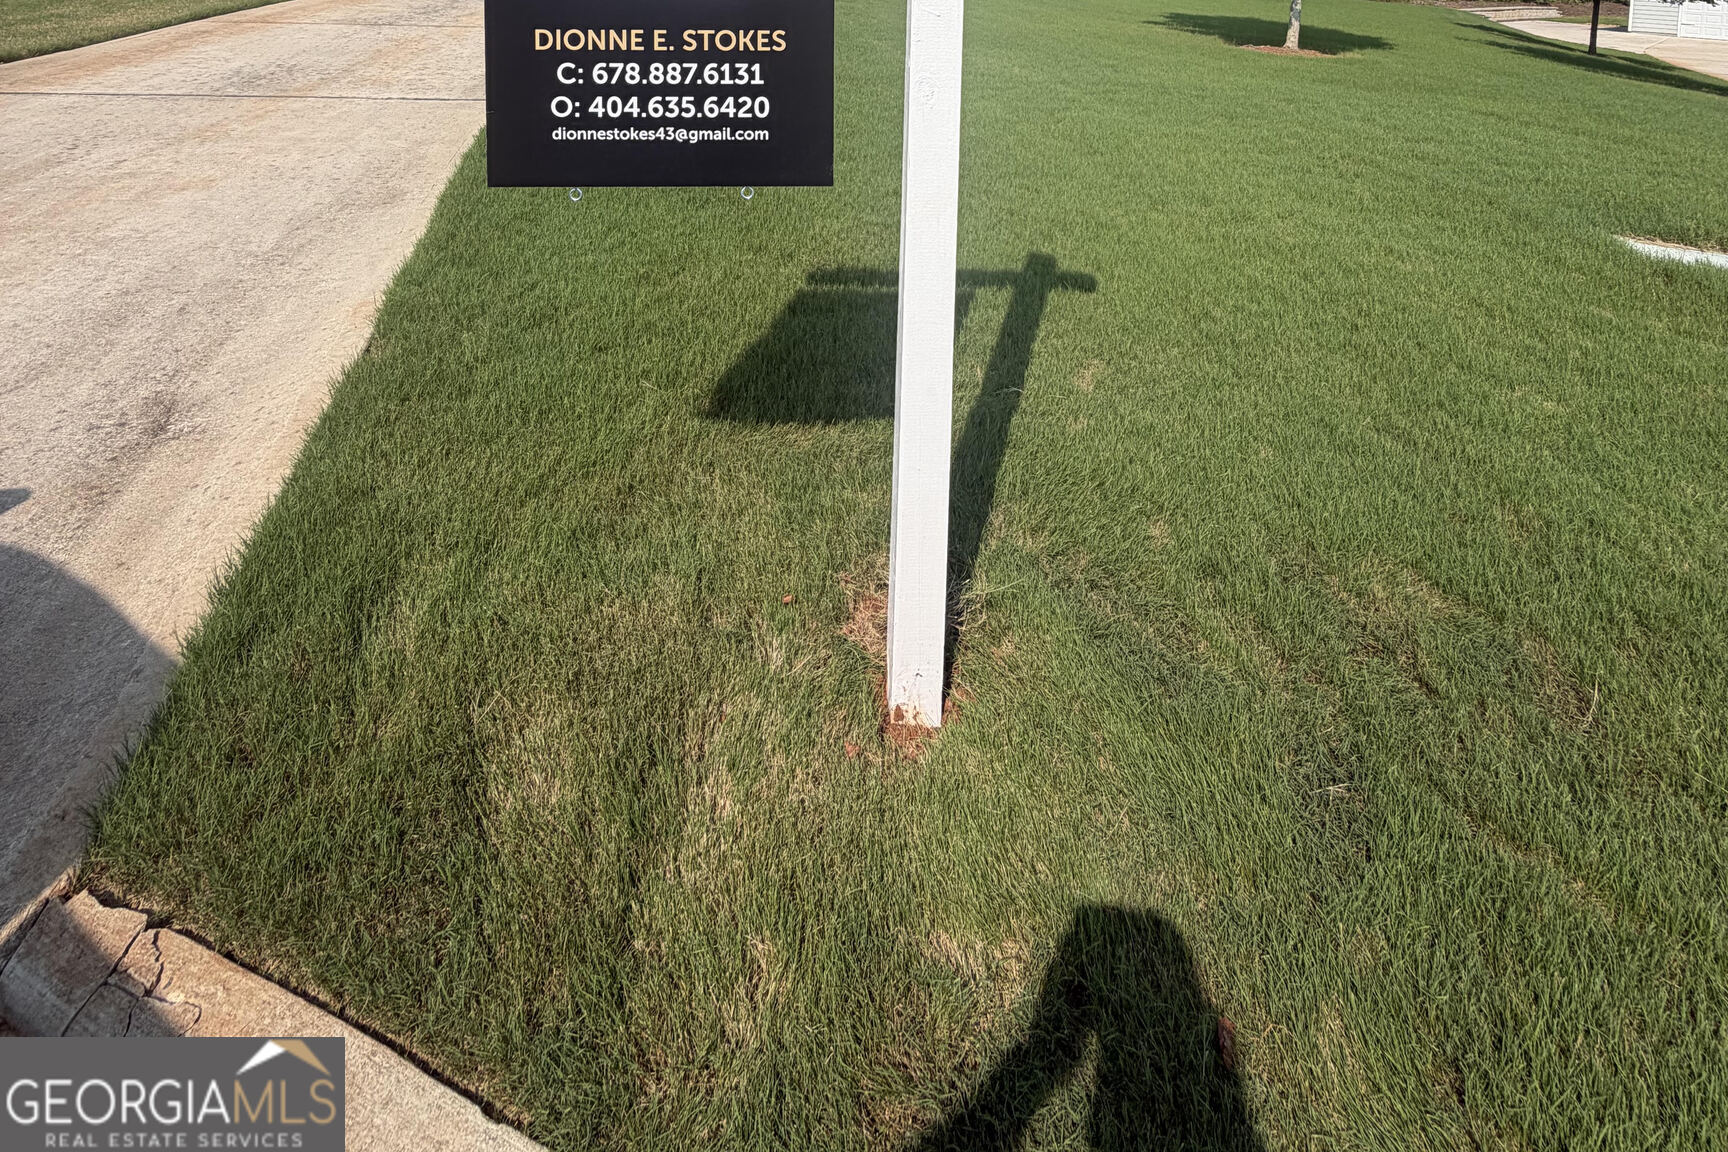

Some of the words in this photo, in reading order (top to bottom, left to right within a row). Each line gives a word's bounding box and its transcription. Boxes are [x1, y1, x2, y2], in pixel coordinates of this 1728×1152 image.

[534, 28, 645, 51] DIONNE
[653, 29, 675, 51] E.
[682, 29, 787, 52] STOKES
[556, 62, 584, 85] C:
[592, 62, 765, 85] 678.887.6131
[550, 95, 580, 118] O:
[588, 95, 770, 119] 404.635.6420
[551, 126, 769, 144] dionnestokes43@gmail.com
